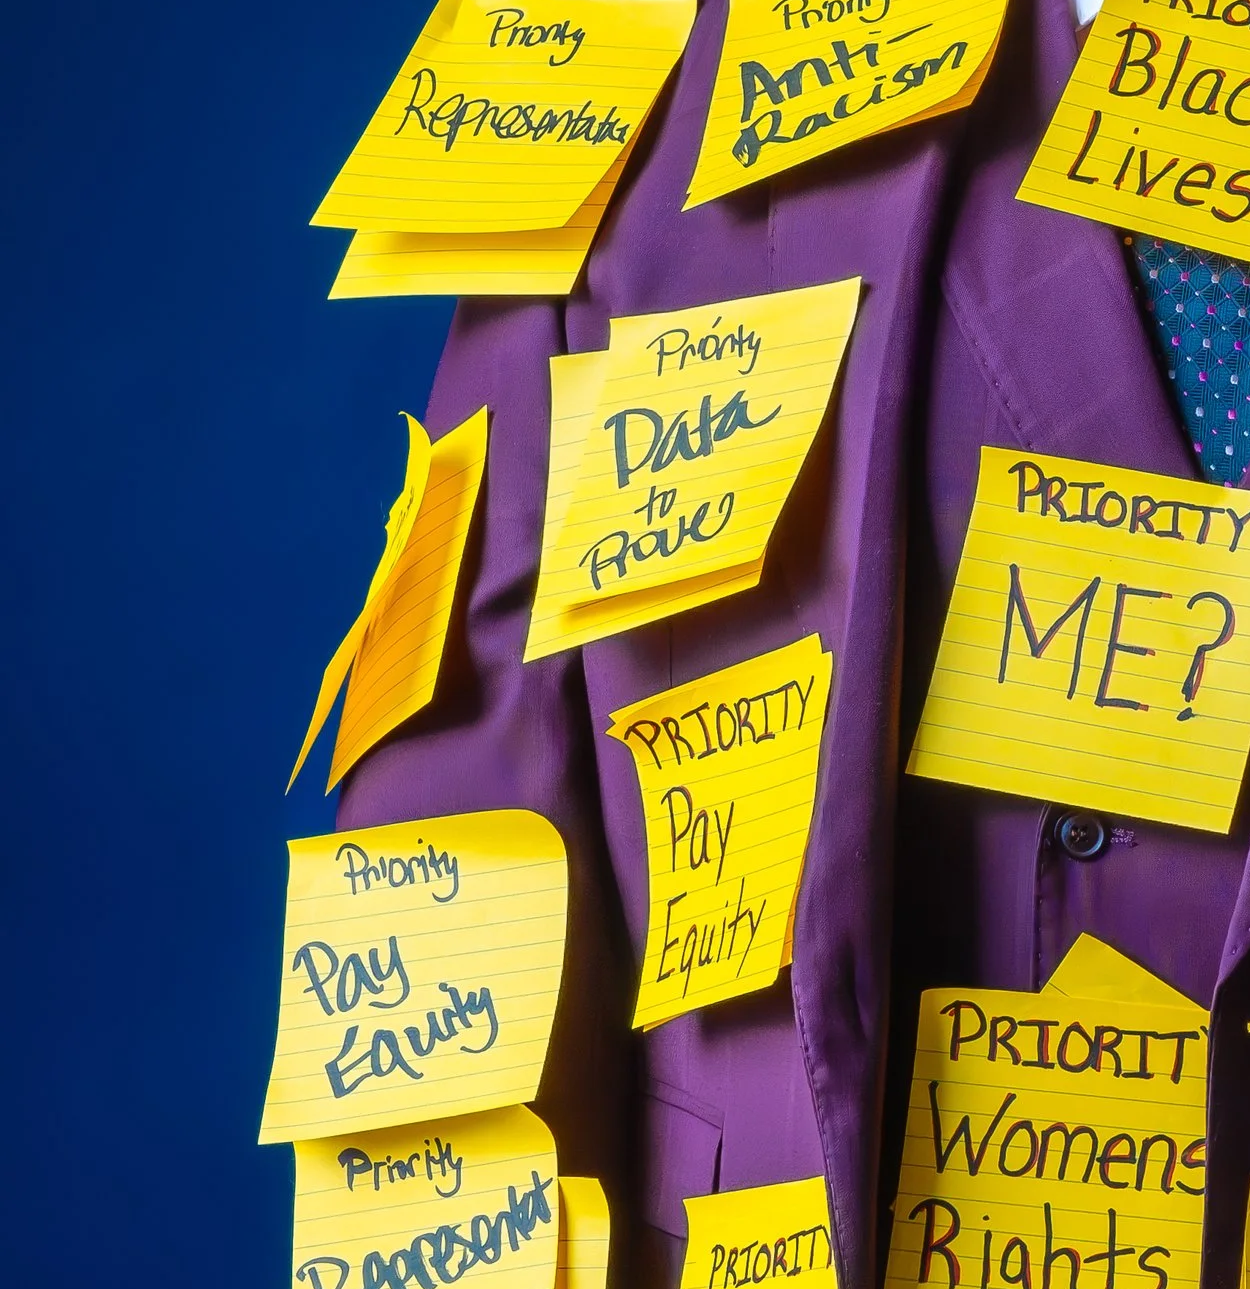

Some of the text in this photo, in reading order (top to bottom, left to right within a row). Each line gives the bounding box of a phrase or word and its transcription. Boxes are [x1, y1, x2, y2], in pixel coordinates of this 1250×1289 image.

[732, 41, 968, 168] Racism
[739, 24, 933, 123] Anti-
[646, 316, 761, 376] Priority
[604, 389, 782, 489] Data
[634, 485, 677, 526] to
[998, 563, 1235, 722] ME?
[624, 675, 815, 769] PRIORITY
[336, 838, 459, 903] Priority
[661, 785, 734, 887] Pay
[292, 936, 410, 1016] Pay
[656, 877, 767, 999] Equity
[325, 983, 499, 1099] Equity
[940, 1000, 1209, 1084] PRIORIT
[337, 1137, 463, 1198] Priority
[928, 1081, 1206, 1195] Womens
